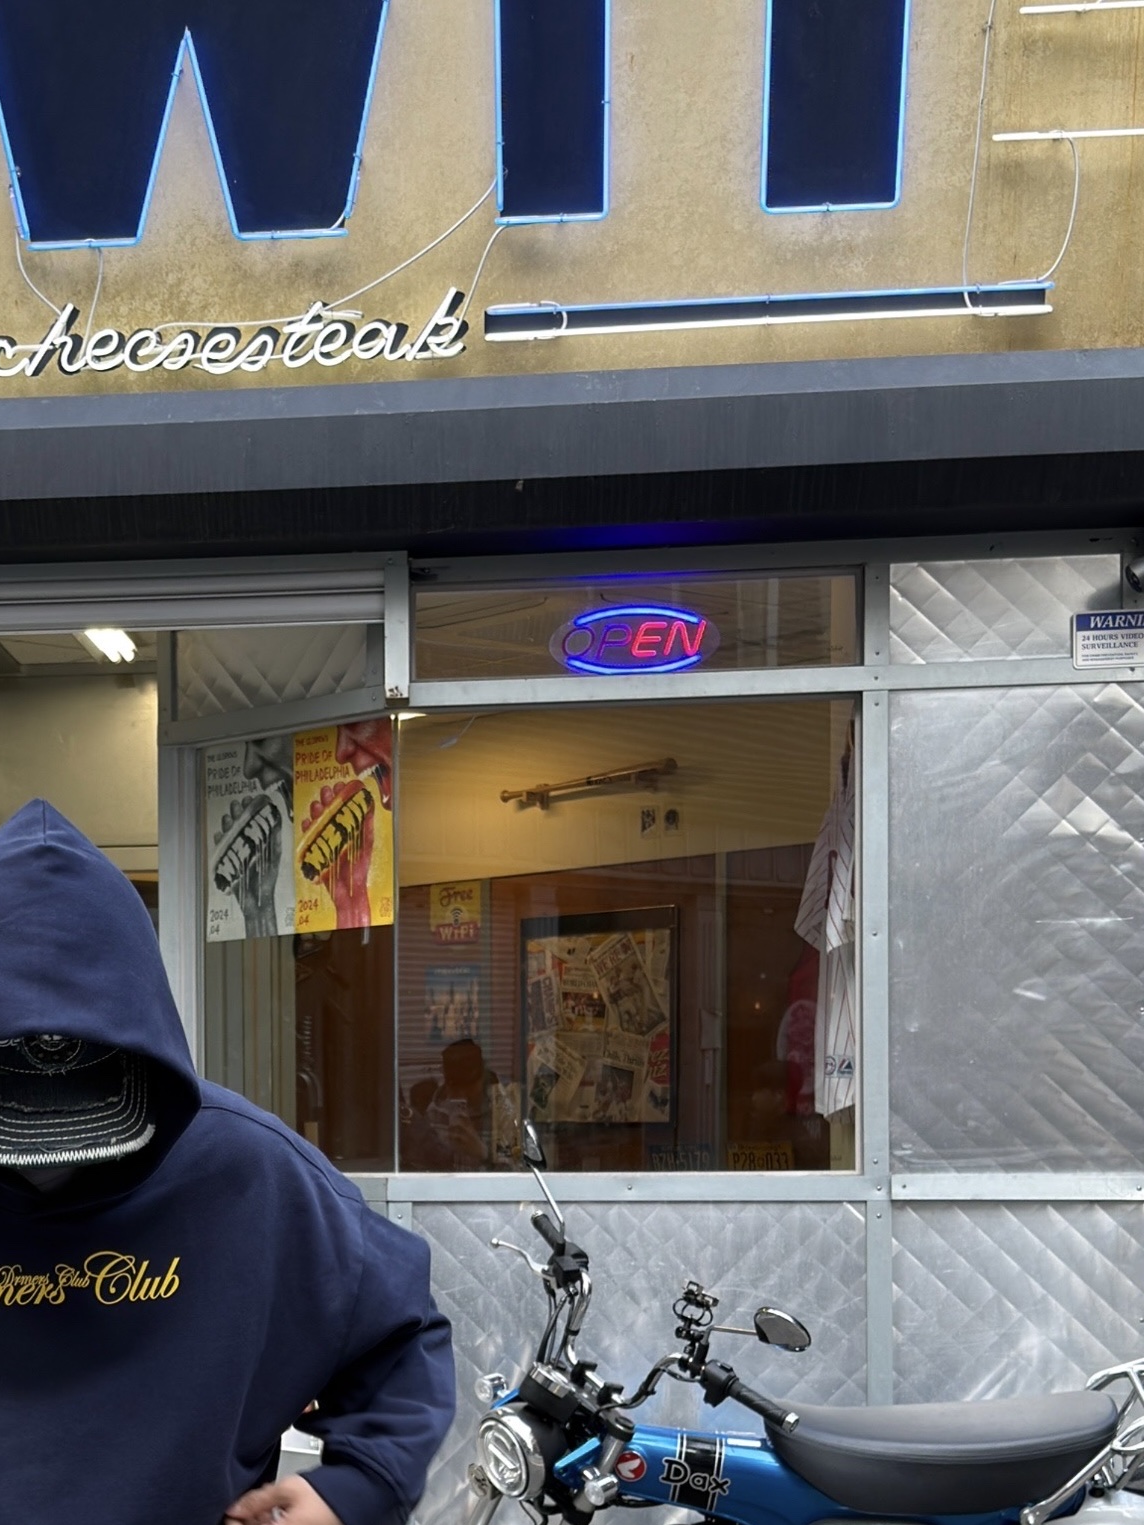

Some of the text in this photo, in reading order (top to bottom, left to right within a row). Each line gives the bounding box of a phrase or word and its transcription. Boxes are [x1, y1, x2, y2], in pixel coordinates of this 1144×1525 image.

[562, 619, 707, 661] OPEN
[1081, 634, 1090, 642] 24
[1092, 633, 1118, 642] HOURS
[1081, 641, 1139, 651] SURVEILLANCE
[296, 750, 333, 765] PRIDE OF
[208, 766, 242, 780] PRIDE OF
[296, 766, 350, 784] PHILADELPHIA
[208, 780, 258, 798] PHILADELPHIA
[298, 898, 319, 912] 2024
[439, 887, 473, 906] Free
[209, 908, 229, 922] 2024
[55, 1263, 92, 1288] Club
[84, 1250, 181, 1305] Club
[659, 1457, 731, 1496] Dax
